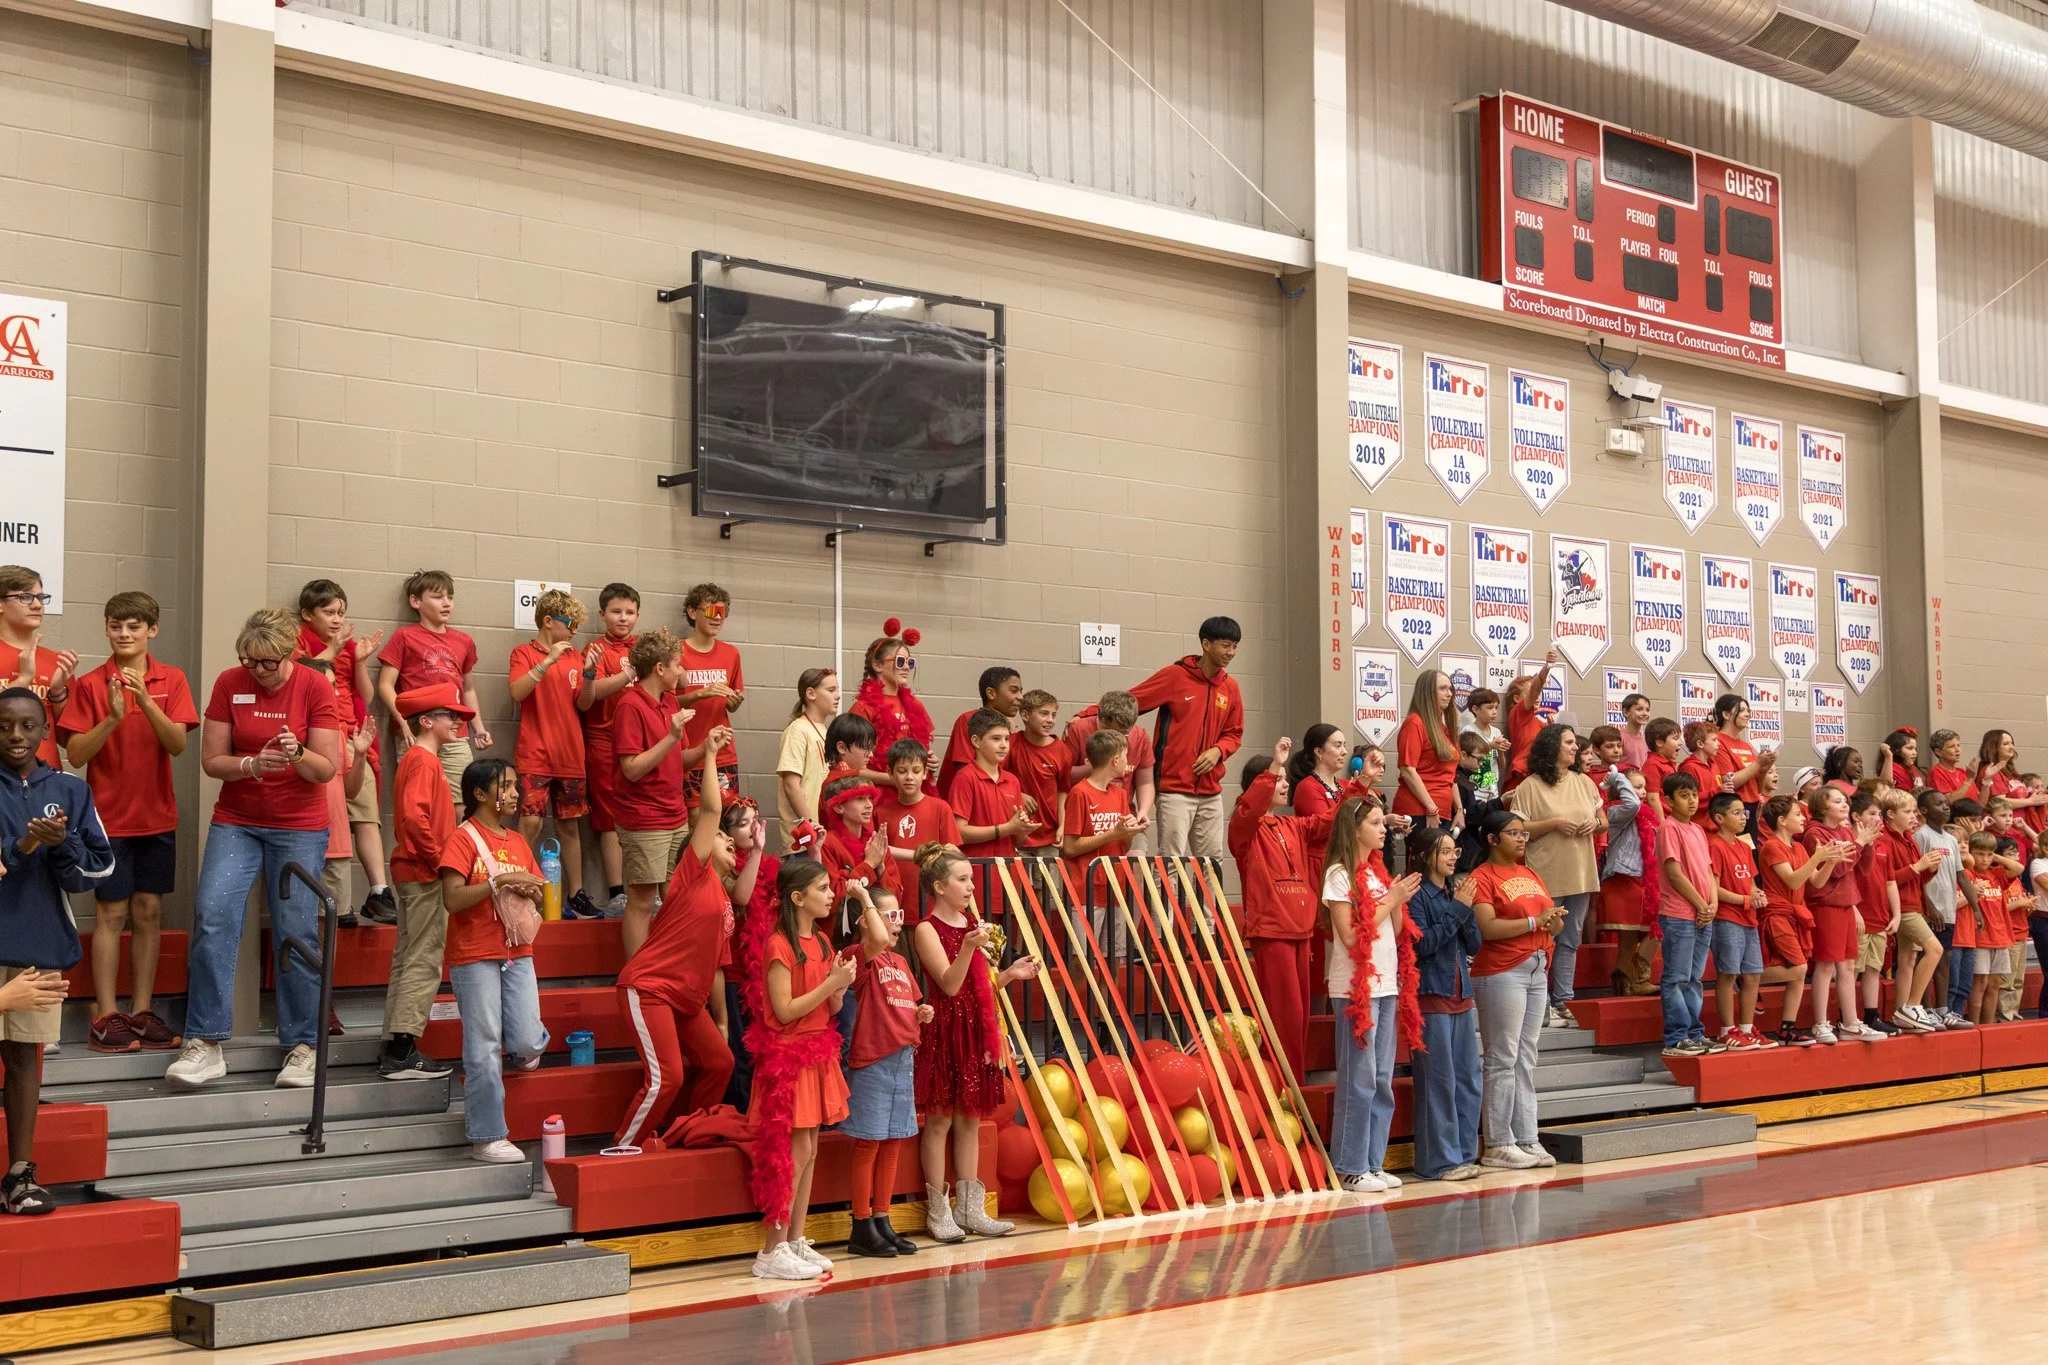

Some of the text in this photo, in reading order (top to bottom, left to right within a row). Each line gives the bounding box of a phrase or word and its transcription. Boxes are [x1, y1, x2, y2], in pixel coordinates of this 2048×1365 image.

[1513, 104, 1565, 144] HOME
[1724, 168, 1772, 204] GUEST
[1515, 210, 1543, 230] FOULS
[1626, 208, 1656, 228] PERIOD
[1572, 225, 1595, 243] T.O.L.
[1620, 238, 1680, 265] PLAYER FOUL
[1515, 267, 1545, 286] SCORE
[1703, 259, 1724, 276] T.O.L.
[1749, 270, 1773, 289] FOULS
[1637, 295, 1666, 315] MATCH
[1509, 293, 1573, 321] Scoreboard
[1575, 306, 1622, 333] Donated
[1624, 316, 1637, 338] by
[1639, 322, 1675, 344] Electra
[1676, 330, 1740, 356] Construction
[1763, 349, 1781, 366] Inc.
[1749, 321, 1774, 340] SCORE
[1359, 401, 1399, 423] VOLLEYBALL
[1348, 418, 1399, 443] HAMPIONS
[1431, 415, 1485, 439] VOLLEYBALL
[1430, 433, 1485, 458] CHAMPION
[1514, 427, 1565, 452] VOLLEYBALL
[1356, 443, 1385, 465] 2018
[1453, 454, 1466, 469] 1A
[1514, 444, 1565, 470] CHAMPION
[1667, 454, 1712, 476] VOLLEYBALL
[1447, 469, 1471, 485] 2018
[1526, 468, 1553, 486] 2020
[1667, 470, 1713, 491] CHAMPION
[1736, 467, 1779, 487] BASKETBALL
[1535, 488, 1547, 499] 1A
[1736, 481, 1779, 503] RUNNERUP
[1802, 478, 1842, 496] GIRLS ATHLETICS
[1678, 491, 1702, 507] 2021
[1802, 490, 1842, 510] CHAMPION
[1686, 509, 1697, 521] 1A
[1747, 503, 1769, 519] 2021
[1812, 512, 1833, 527] 2021
[1754, 520, 1765, 532] 1A
[1819, 529, 1828, 540] 1A
[1388, 575, 1445, 599] BASKETBALL
[1475, 584, 1528, 605] BASKETBALL
[1327, 526, 1343, 672] WARRIORS
[1388, 594, 1445, 618] CHAMPIONS
[1475, 601, 1529, 624] CHAMPIONS
[1635, 600, 1683, 620] TENNIS
[1706, 609, 1750, 627] VOLLEYBALL
[1402, 618, 1432, 636] 2022
[1488, 624, 1516, 641] 2022
[1555, 620, 1606, 642] CHAMPION
[1635, 615, 1683, 636] CHAMPION
[1706, 624, 1750, 643] CHAMPION
[1773, 616, 1815, 634] VOLLEYBALL
[1848, 623, 1871, 639] GOLF
[1084, 635, 1116, 647] GRADE
[1411, 638, 1424, 650] 1A
[1497, 644, 1509, 655] 1A
[1646, 637, 1671, 653] 2023
[1773, 631, 1815, 651] CHAMPION
[1840, 637, 1880, 656] CHAMPION
[1096, 647, 1103, 657] 4
[1654, 655, 1664, 667] 1A
[1718, 645, 1741, 659] 2023
[1784, 651, 1806, 666] 2024
[1931, 597, 1943, 710] WARRIORS
[1489, 667, 1515, 678] GRADE
[1726, 662, 1735, 673] 1A
[1791, 668, 1800, 679] 1A
[1850, 658, 1871, 671] 2025
[1498, 678, 1503, 687] 3
[1857, 674, 1865, 684] 1A
[1787, 689, 1806, 698] GRADE
[1794, 698, 1799, 706] 2
[1357, 708, 1397, 722] CHAMPION
[1607, 701, 1622, 711] DIST
[1681, 706, 1712, 717] REGIONA
[1750, 710, 1779, 720] DISTRICT
[1608, 712, 1627, 723] TEN
[1750, 720, 1780, 730] TENNIS
[1815, 714, 1843, 724] DISTRICT
[1750, 730, 1780, 741] CHAMPION
[1815, 725, 1844, 735] TENNIS
